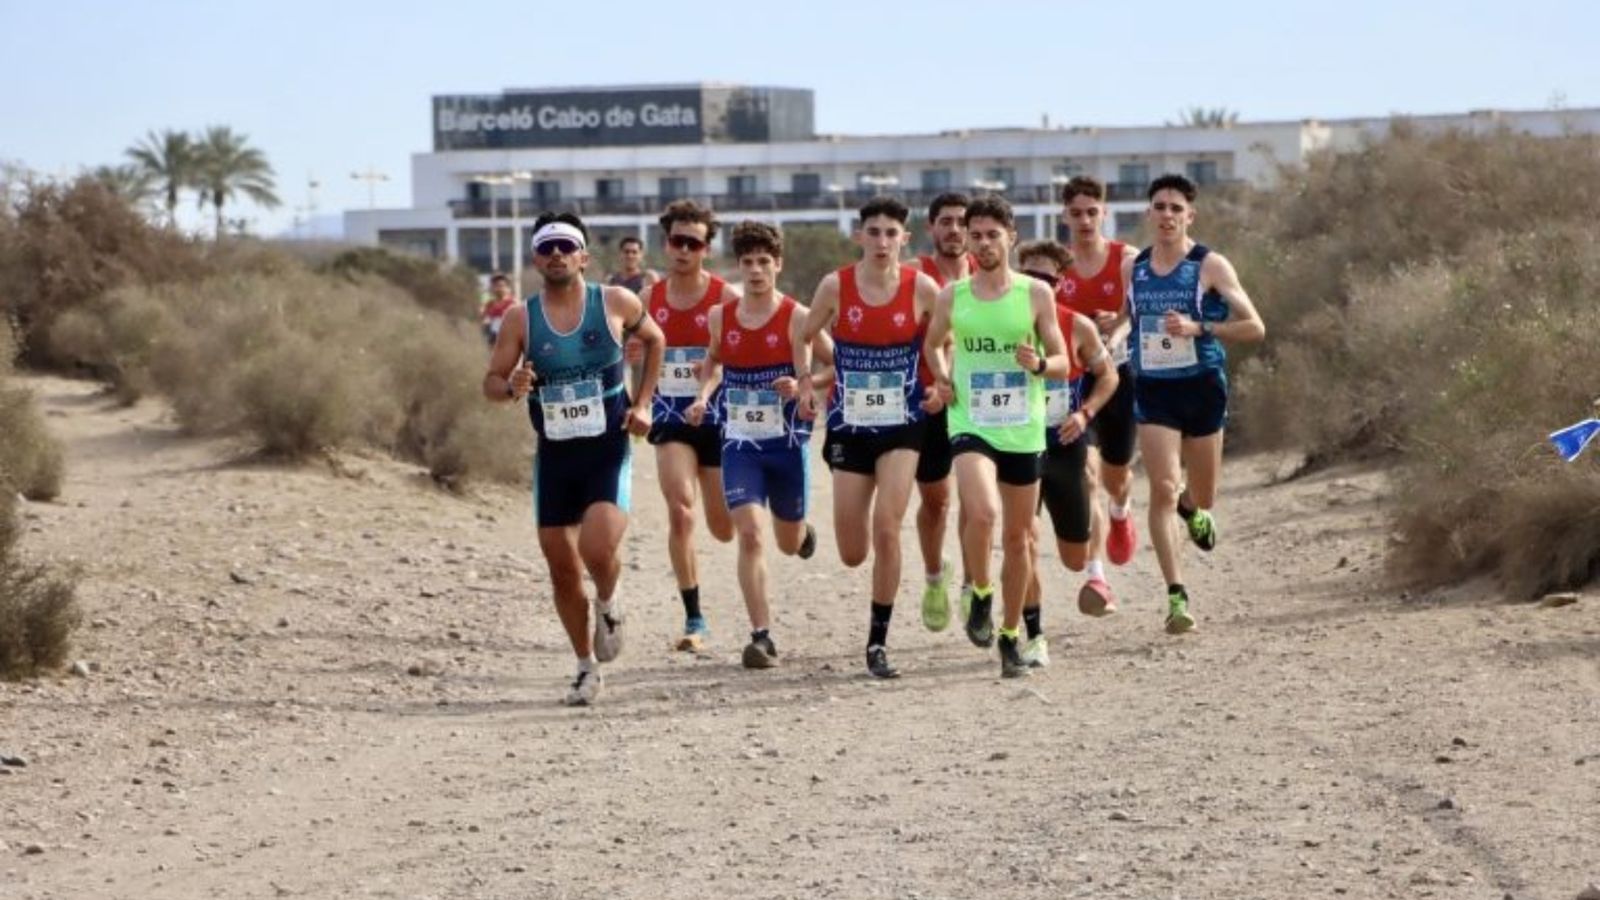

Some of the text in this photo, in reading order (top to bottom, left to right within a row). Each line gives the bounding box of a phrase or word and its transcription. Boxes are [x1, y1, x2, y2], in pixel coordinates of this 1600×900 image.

[438, 102, 697, 131] Barceló Cabo de Gata
[1161, 337, 1172, 350] 6
[674, 367, 692, 379] 63
[865, 393, 886, 406] 58
[991, 393, 1011, 406] 87
[560, 404, 589, 420] 109
[745, 410, 764, 423] 62
